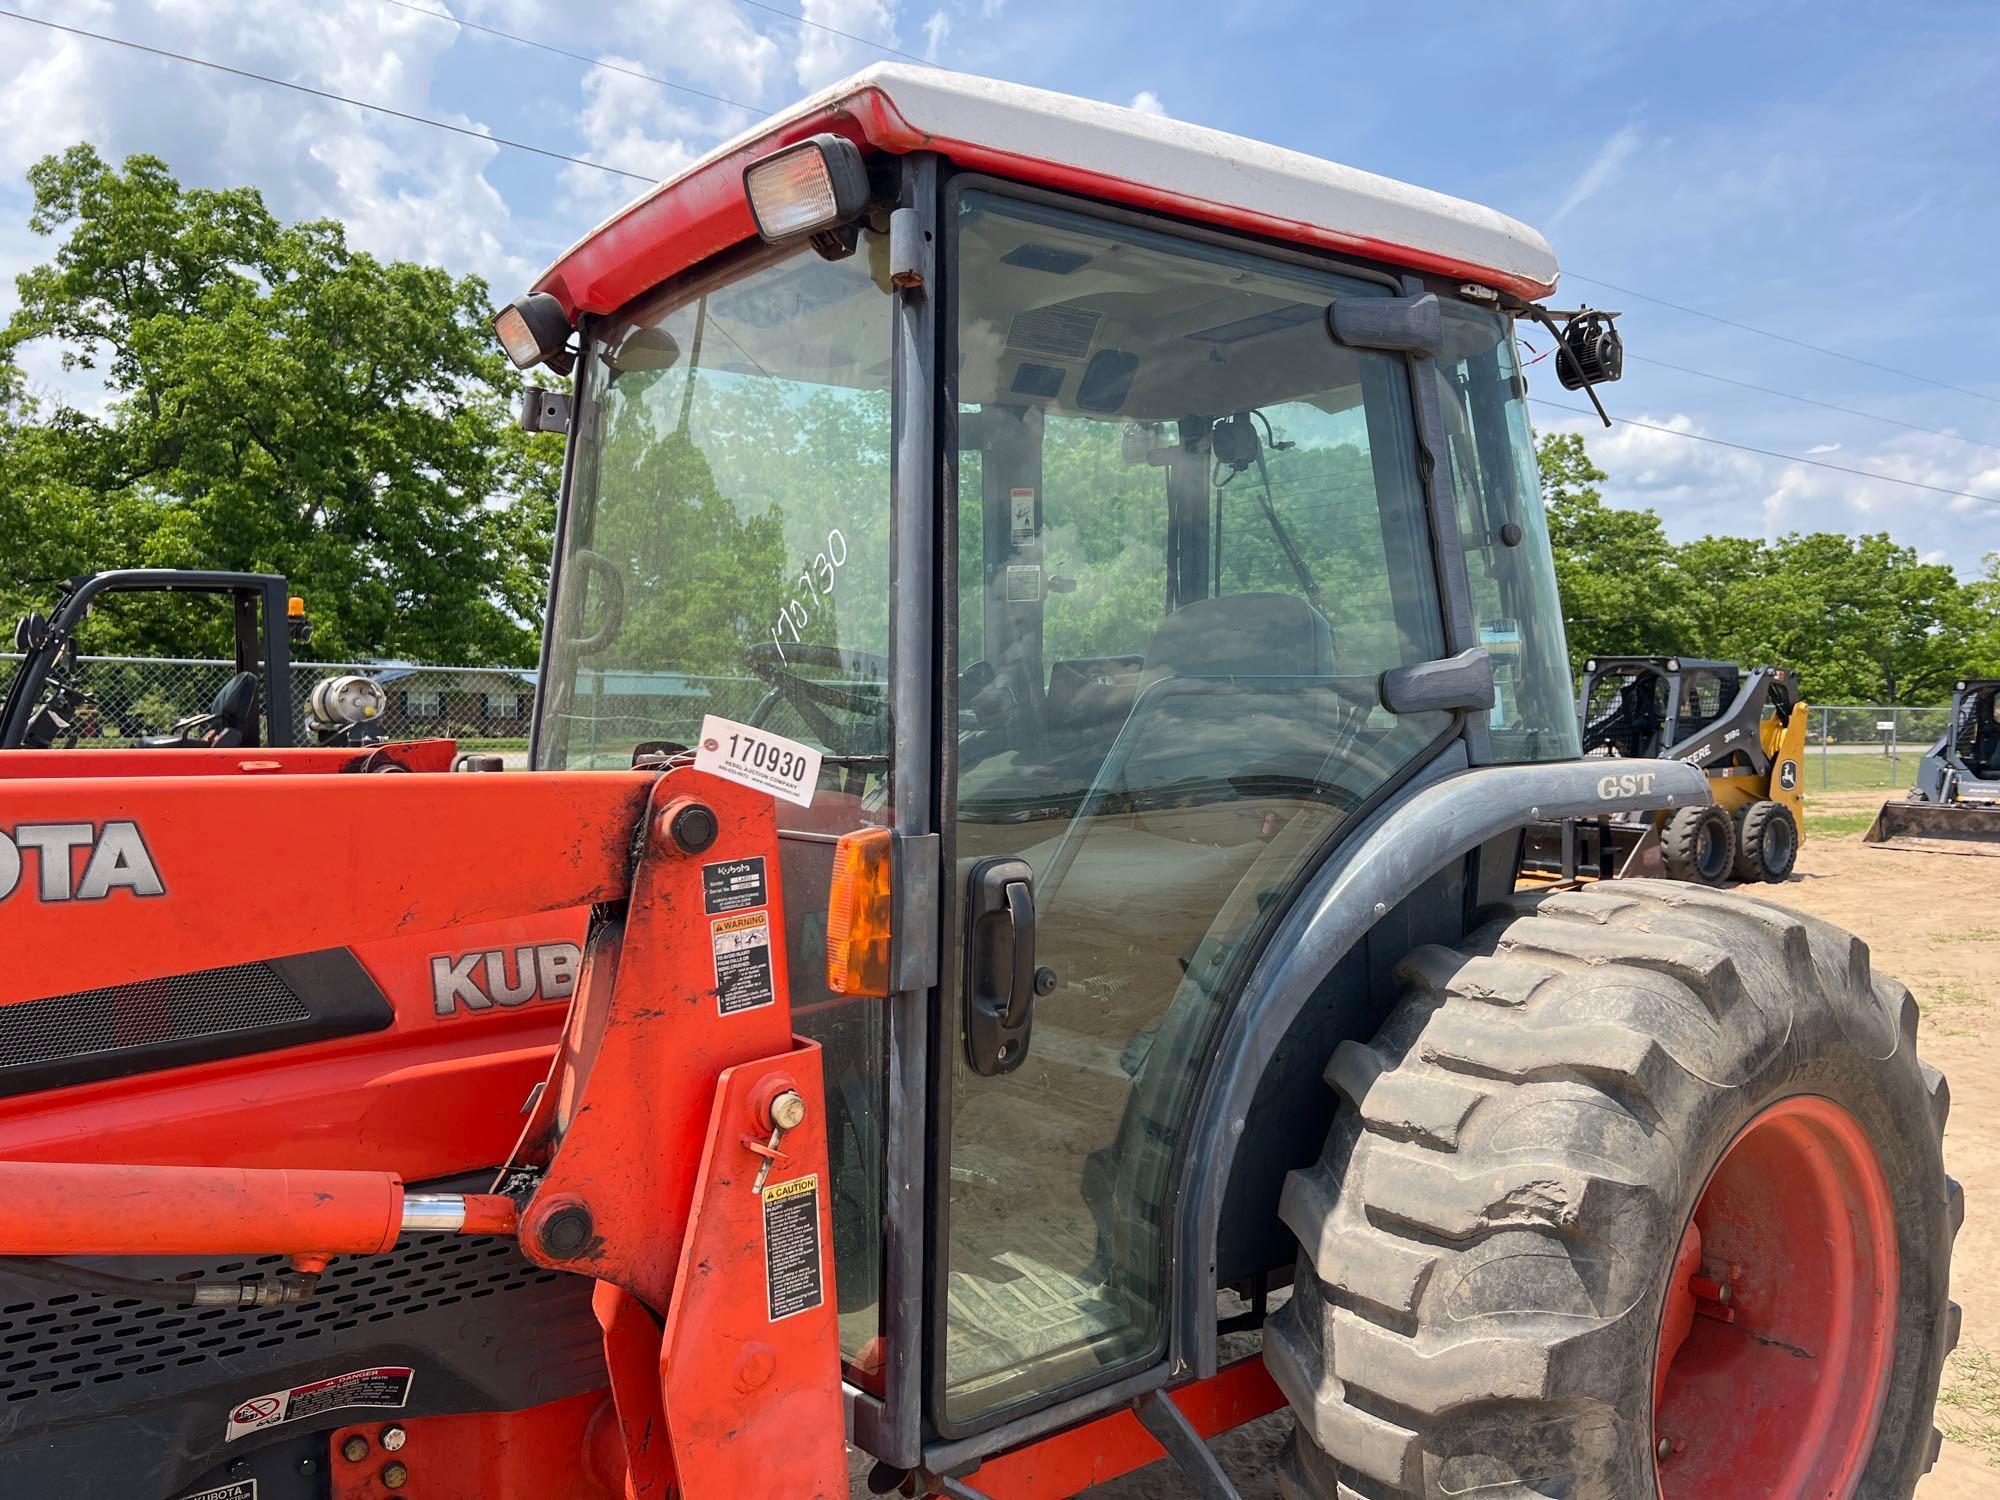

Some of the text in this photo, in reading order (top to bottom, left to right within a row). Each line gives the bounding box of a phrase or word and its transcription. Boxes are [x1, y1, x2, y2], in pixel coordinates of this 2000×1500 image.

[729, 733, 806, 782] 170930
[725, 760, 799, 790] REBEL AUCTION COMPANY
[1597, 772, 1656, 800] GST
[0, 820, 167, 904] TA
[718, 864, 750, 875] Kubota
[724, 915, 765, 930] WARNING
[776, 1180, 814, 1197] CAUTION
[339, 1370, 379, 1383] DANGER
